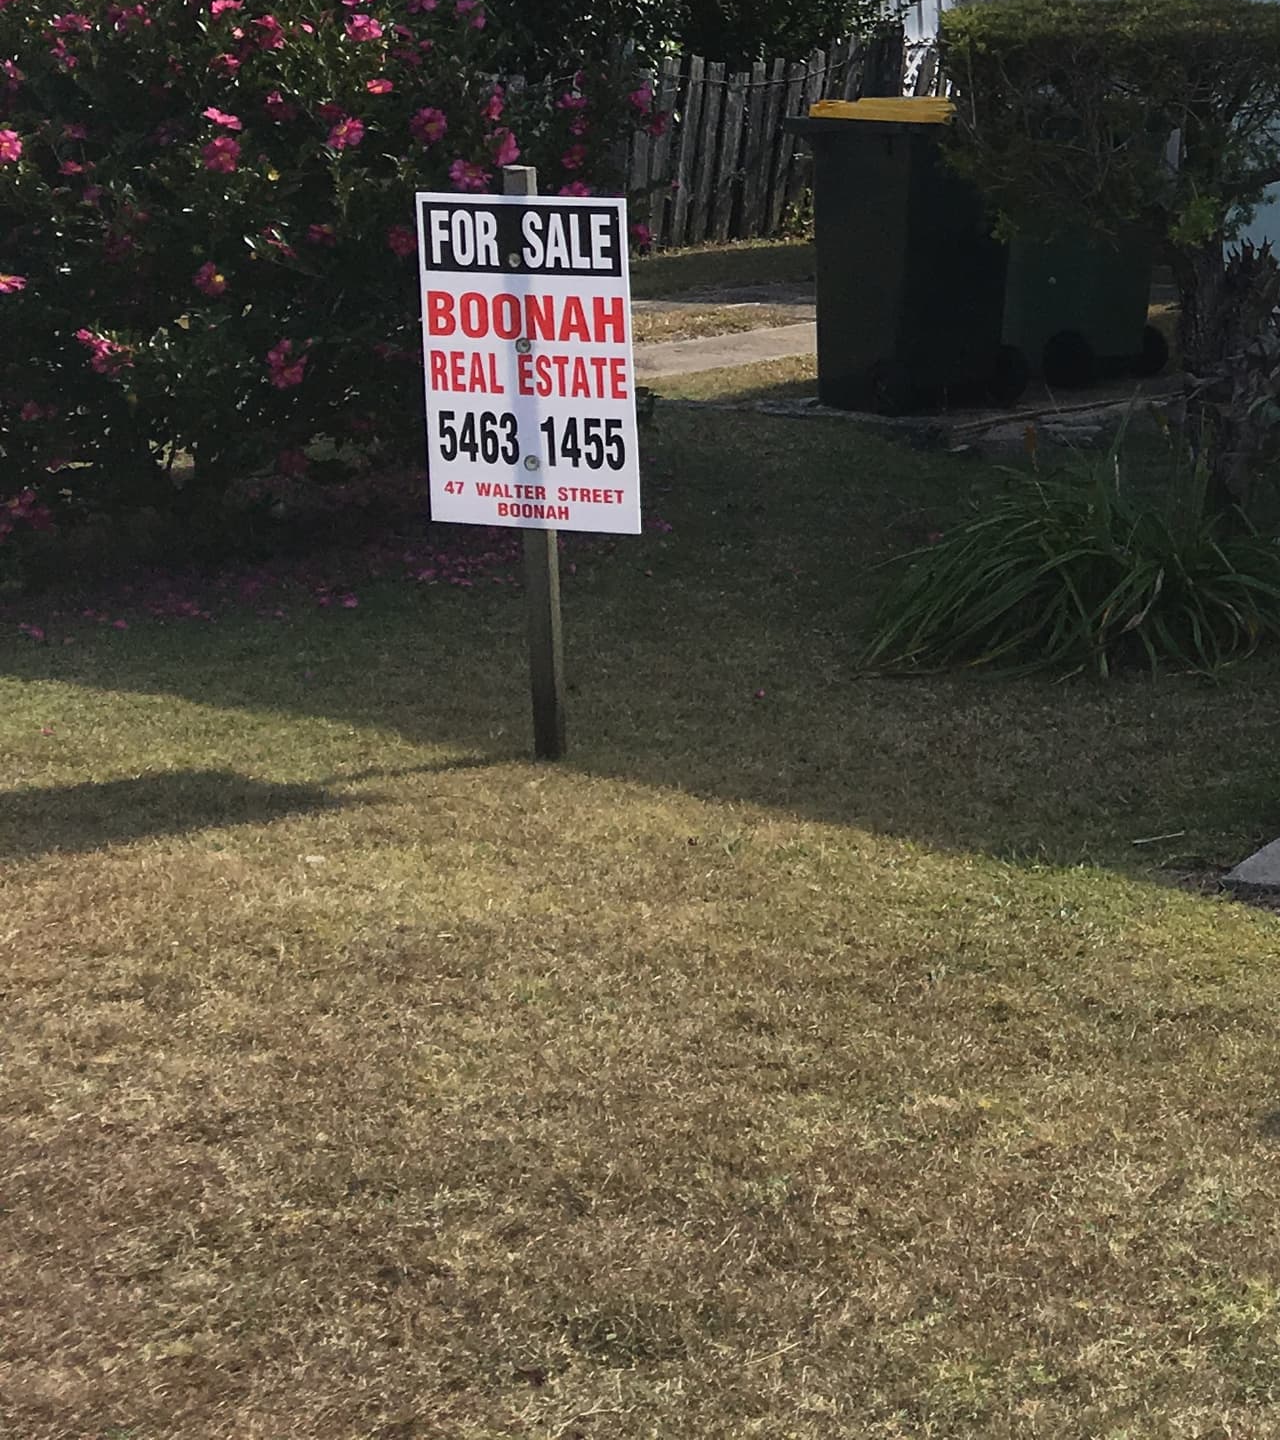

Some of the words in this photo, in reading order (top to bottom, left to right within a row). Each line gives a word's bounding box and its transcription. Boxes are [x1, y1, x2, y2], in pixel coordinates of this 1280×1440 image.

[430, 209, 500, 267] FOR
[522, 211, 614, 270] SALE
[427, 290, 626, 344] BOONAH
[430, 350, 505, 395] REAL
[518, 354, 628, 400] ESTATE
[438, 410, 520, 466] 5463
[540, 415, 626, 471] 1455
[444, 481, 465, 496] 47
[475, 482, 546, 501] WALTER
[558, 486, 625, 505] STREET
[497, 502, 570, 521] BOONAH
